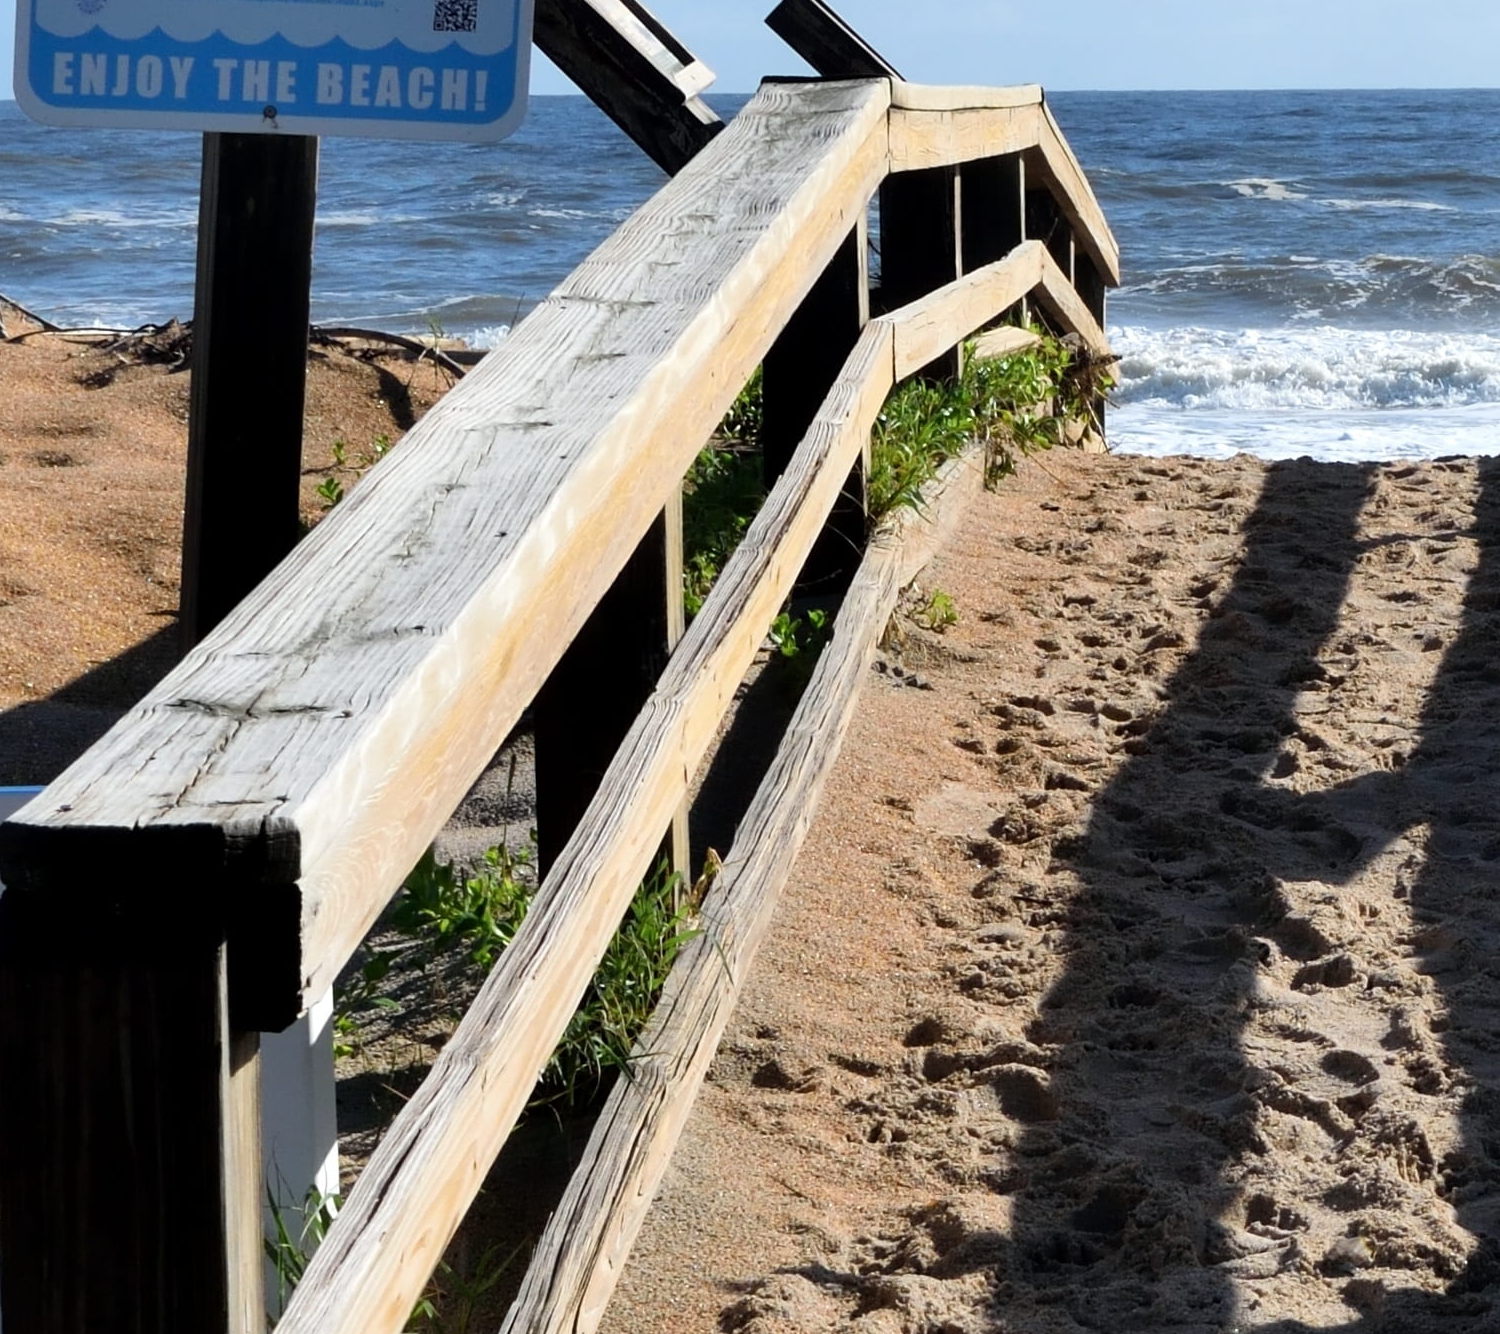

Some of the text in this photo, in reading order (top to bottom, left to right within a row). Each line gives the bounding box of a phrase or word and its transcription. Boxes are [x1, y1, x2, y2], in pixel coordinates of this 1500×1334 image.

[53, 51, 487, 111] ENJOY THE BEACH!
